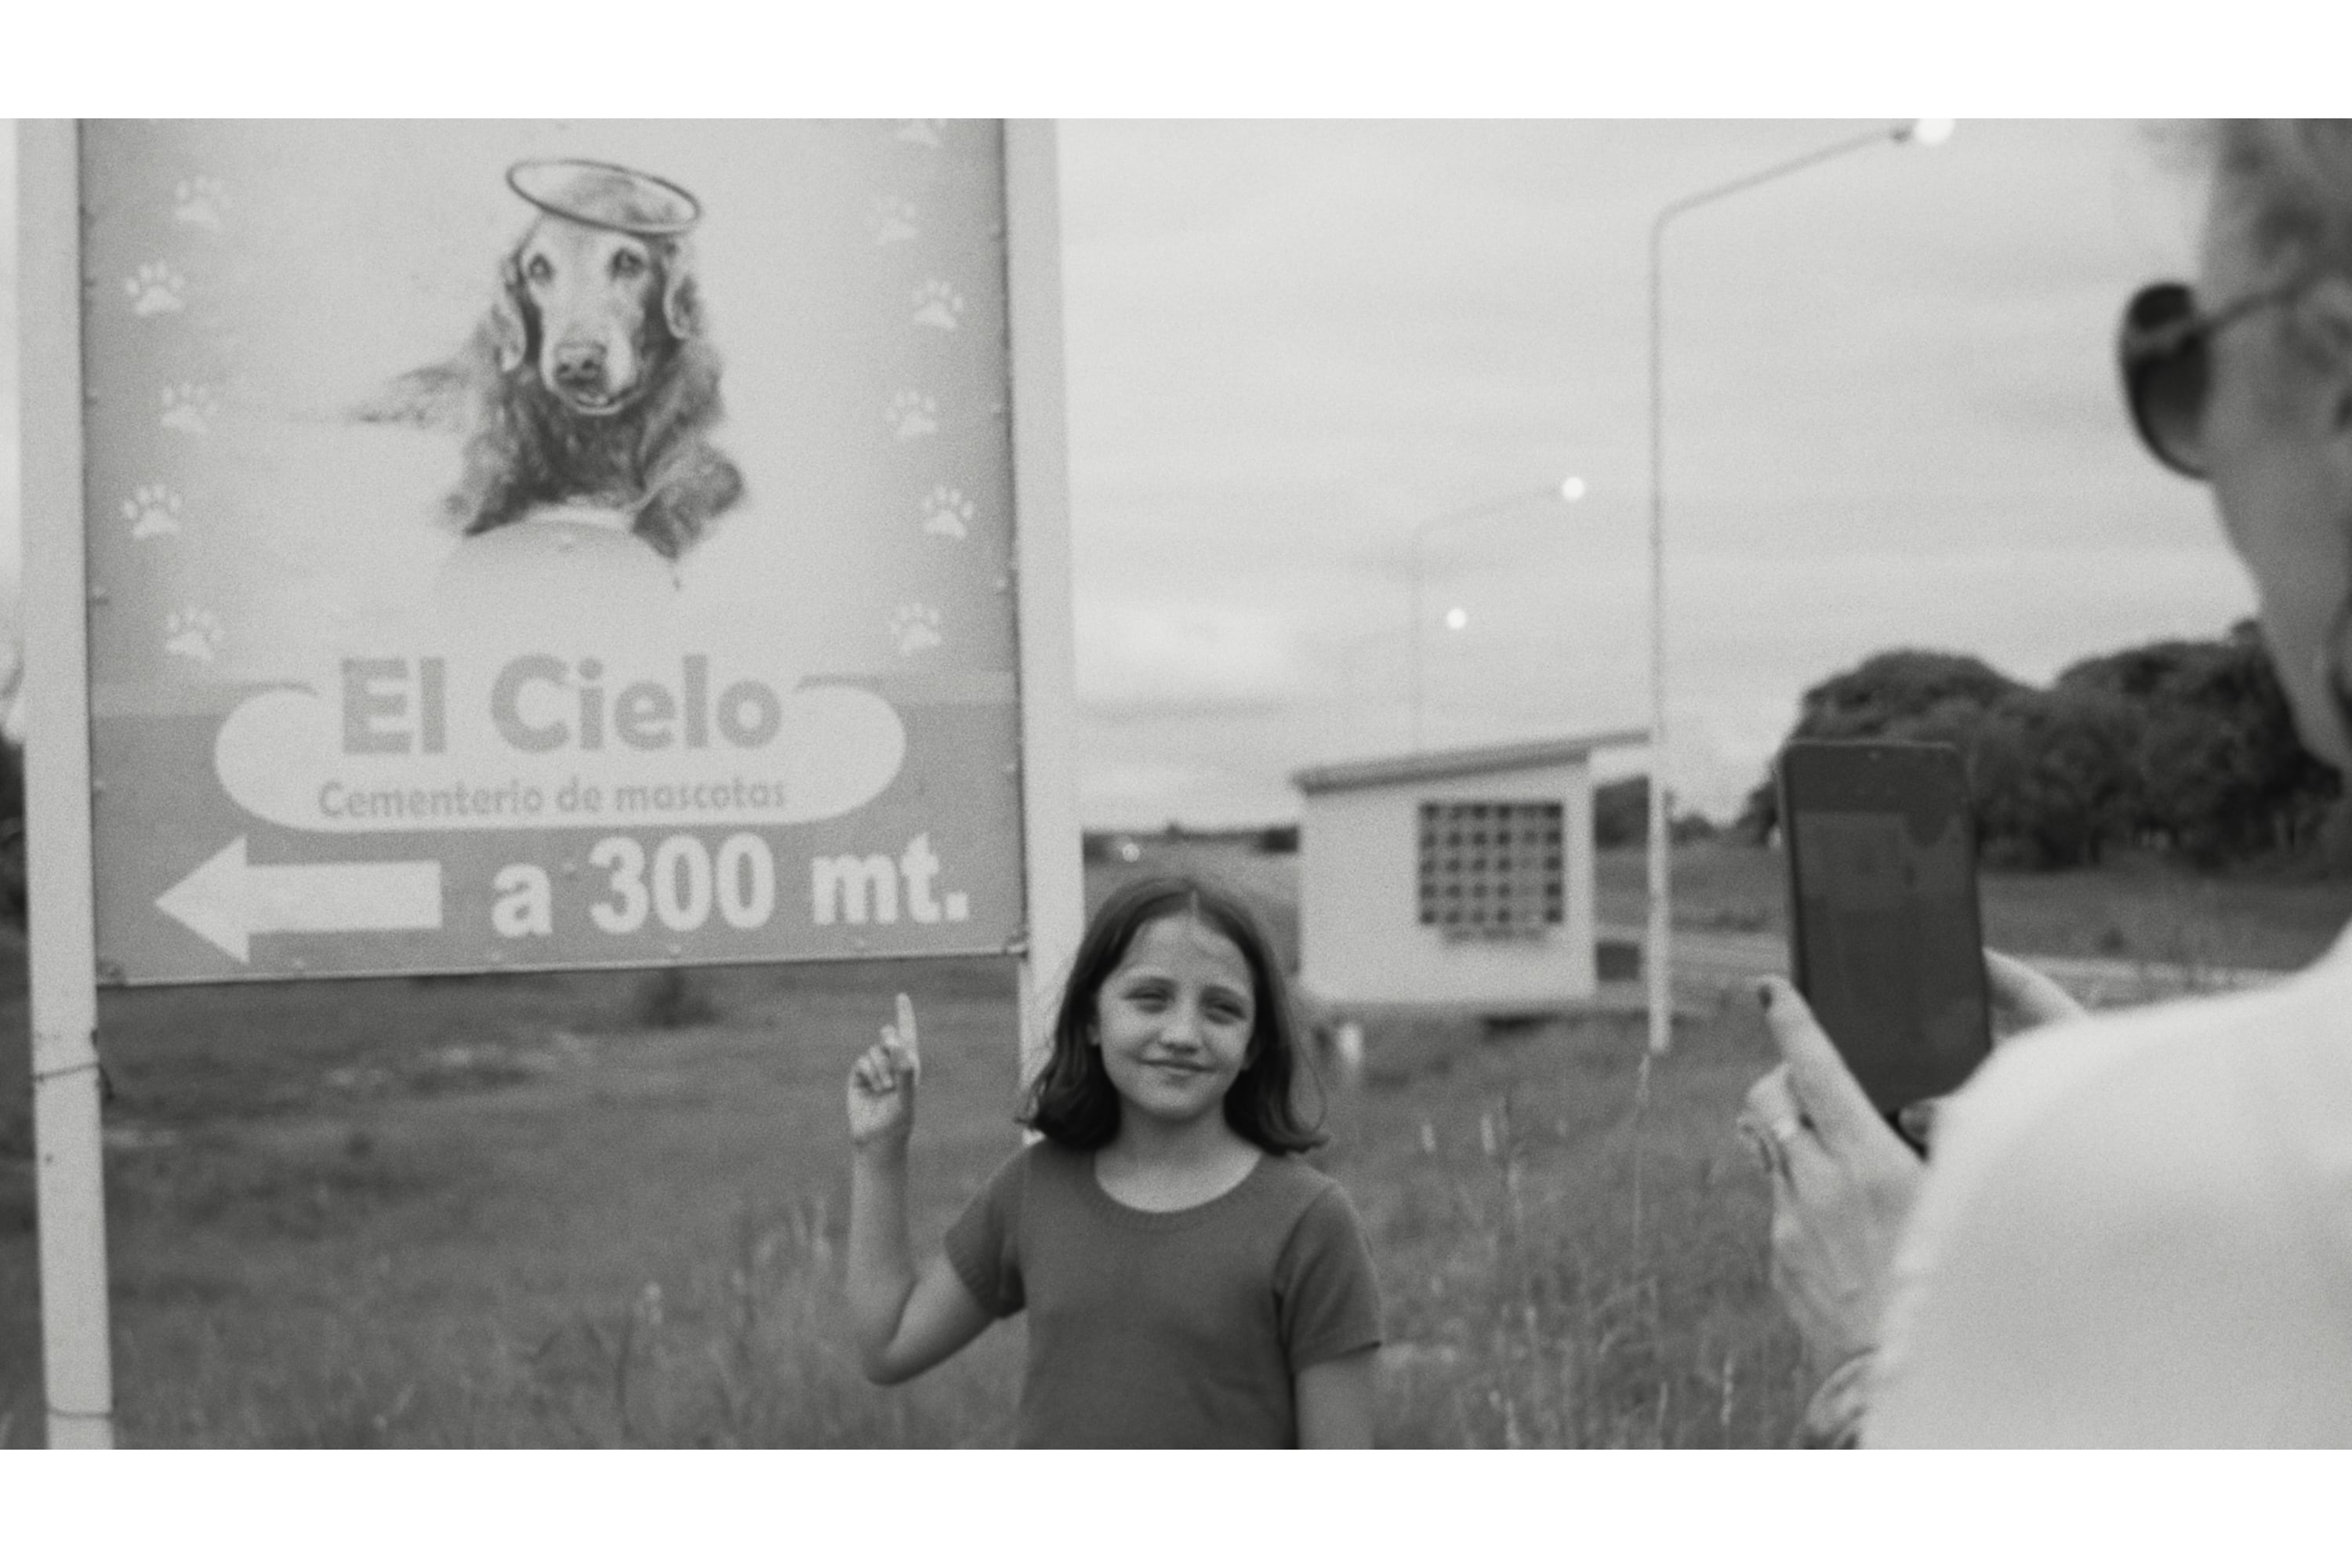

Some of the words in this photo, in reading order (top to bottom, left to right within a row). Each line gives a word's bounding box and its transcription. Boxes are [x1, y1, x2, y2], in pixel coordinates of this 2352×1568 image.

[340, 656, 447, 755] El
[490, 653, 783, 753] Cielo
[320, 777, 546, 819] Cementerio
[556, 775, 605, 815] de
[614, 779, 788, 812] mascotas
[492, 863, 552, 938] a
[588, 833, 776, 933] 300
[811, 833, 970, 926] mt.
